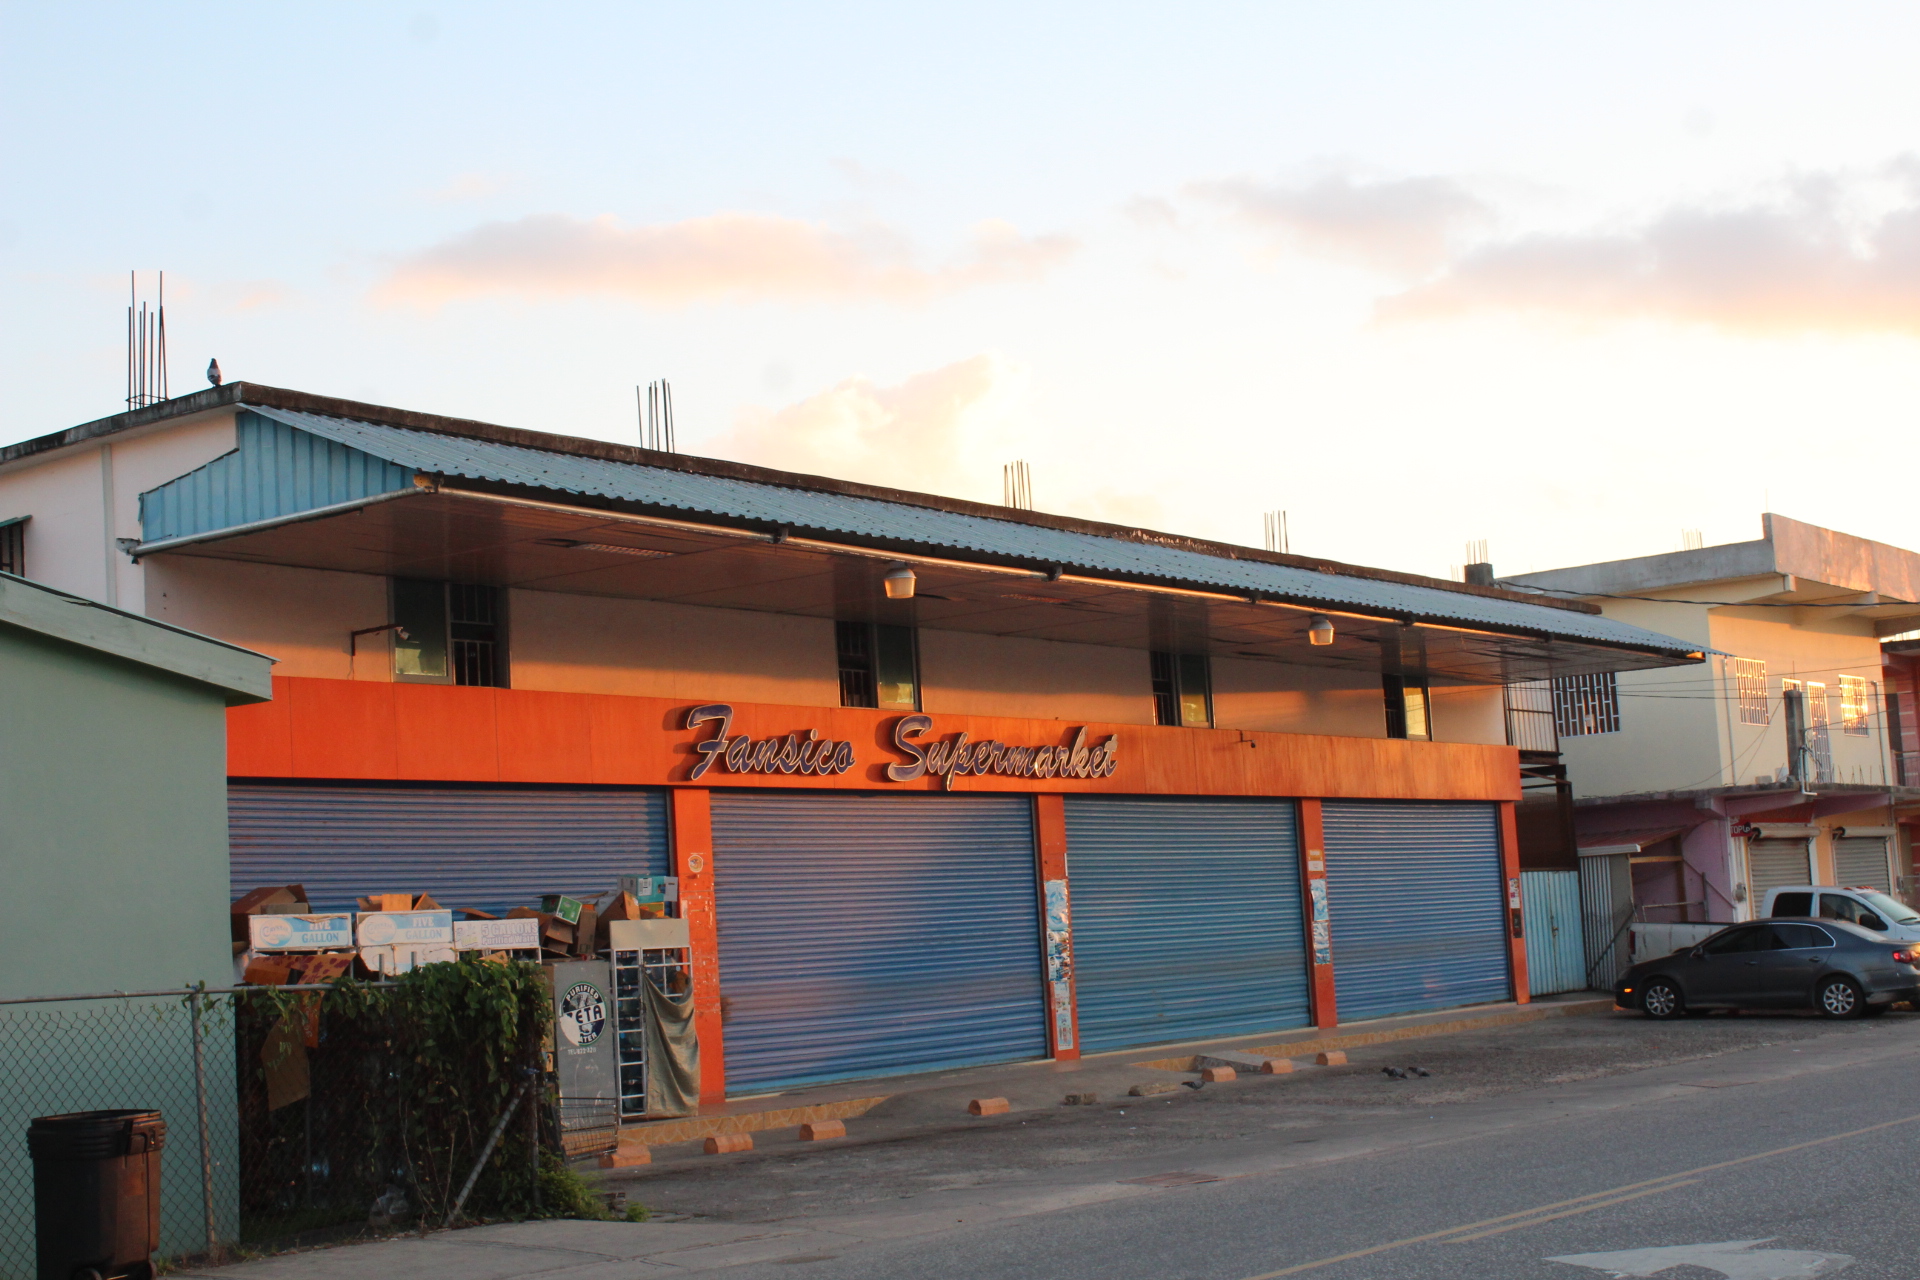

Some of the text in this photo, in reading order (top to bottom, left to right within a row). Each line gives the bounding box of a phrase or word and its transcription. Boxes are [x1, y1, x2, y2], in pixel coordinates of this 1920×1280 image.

[686, 704, 1118, 791] Fansico Supermarket
[309, 920, 331, 931] FIVE
[412, 916, 434, 927] FIVE
[481, 922, 538, 935] 5 GALLONS
[301, 932, 339, 943] GALLON
[405, 929, 442, 940] GALLON
[481, 934, 538, 945] Purified Water
[566, 985, 599, 1001] PURIFIED
[567, 1005, 602, 1024] ETA
